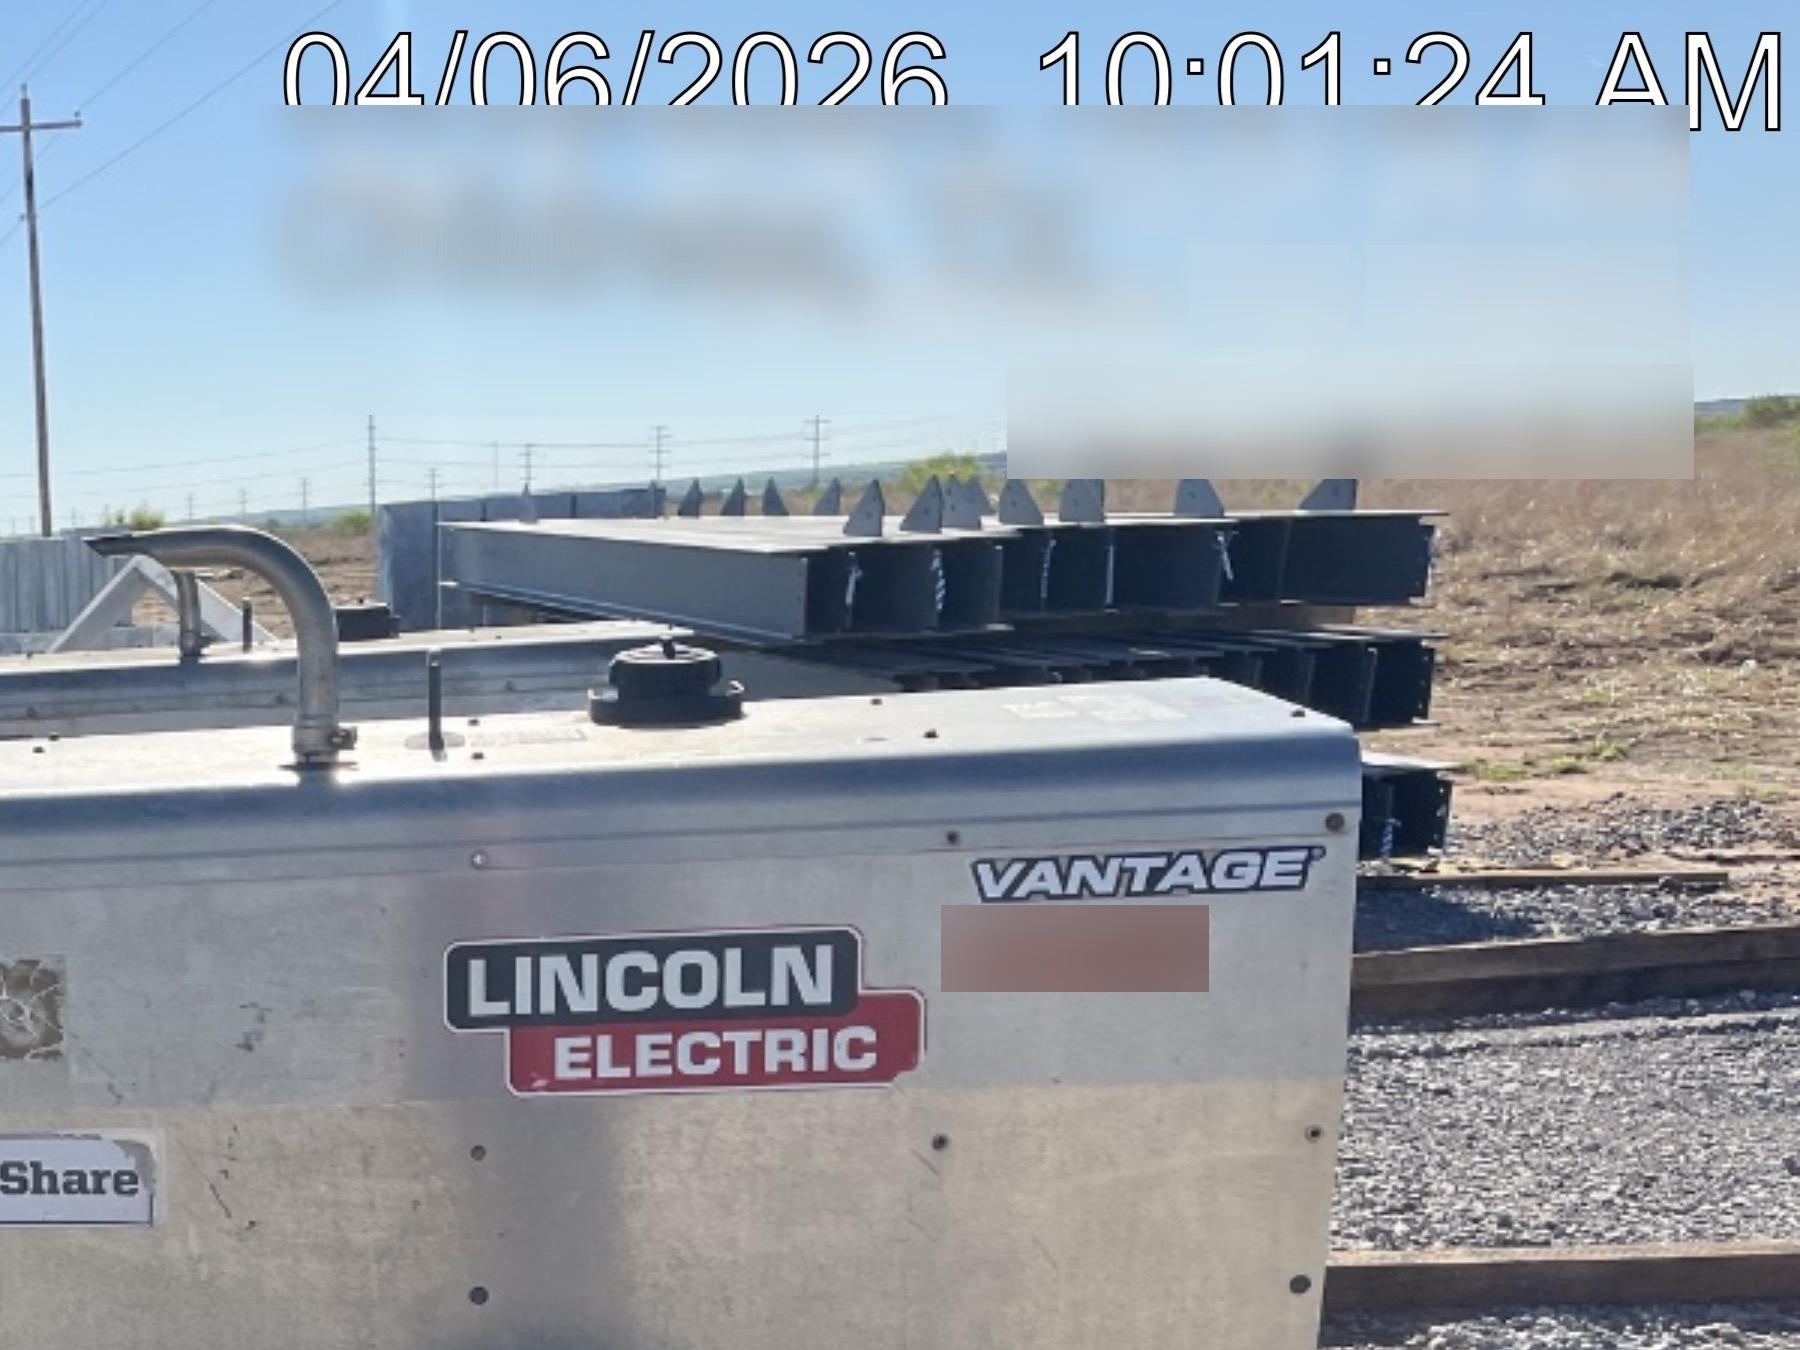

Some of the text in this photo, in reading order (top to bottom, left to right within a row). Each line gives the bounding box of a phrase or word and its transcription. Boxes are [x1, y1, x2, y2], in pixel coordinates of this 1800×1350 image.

[974, 849, 1309, 899] VANTAGE
[467, 944, 834, 1017] LINCOLN
[553, 1025, 878, 1080] ELECTRIC
